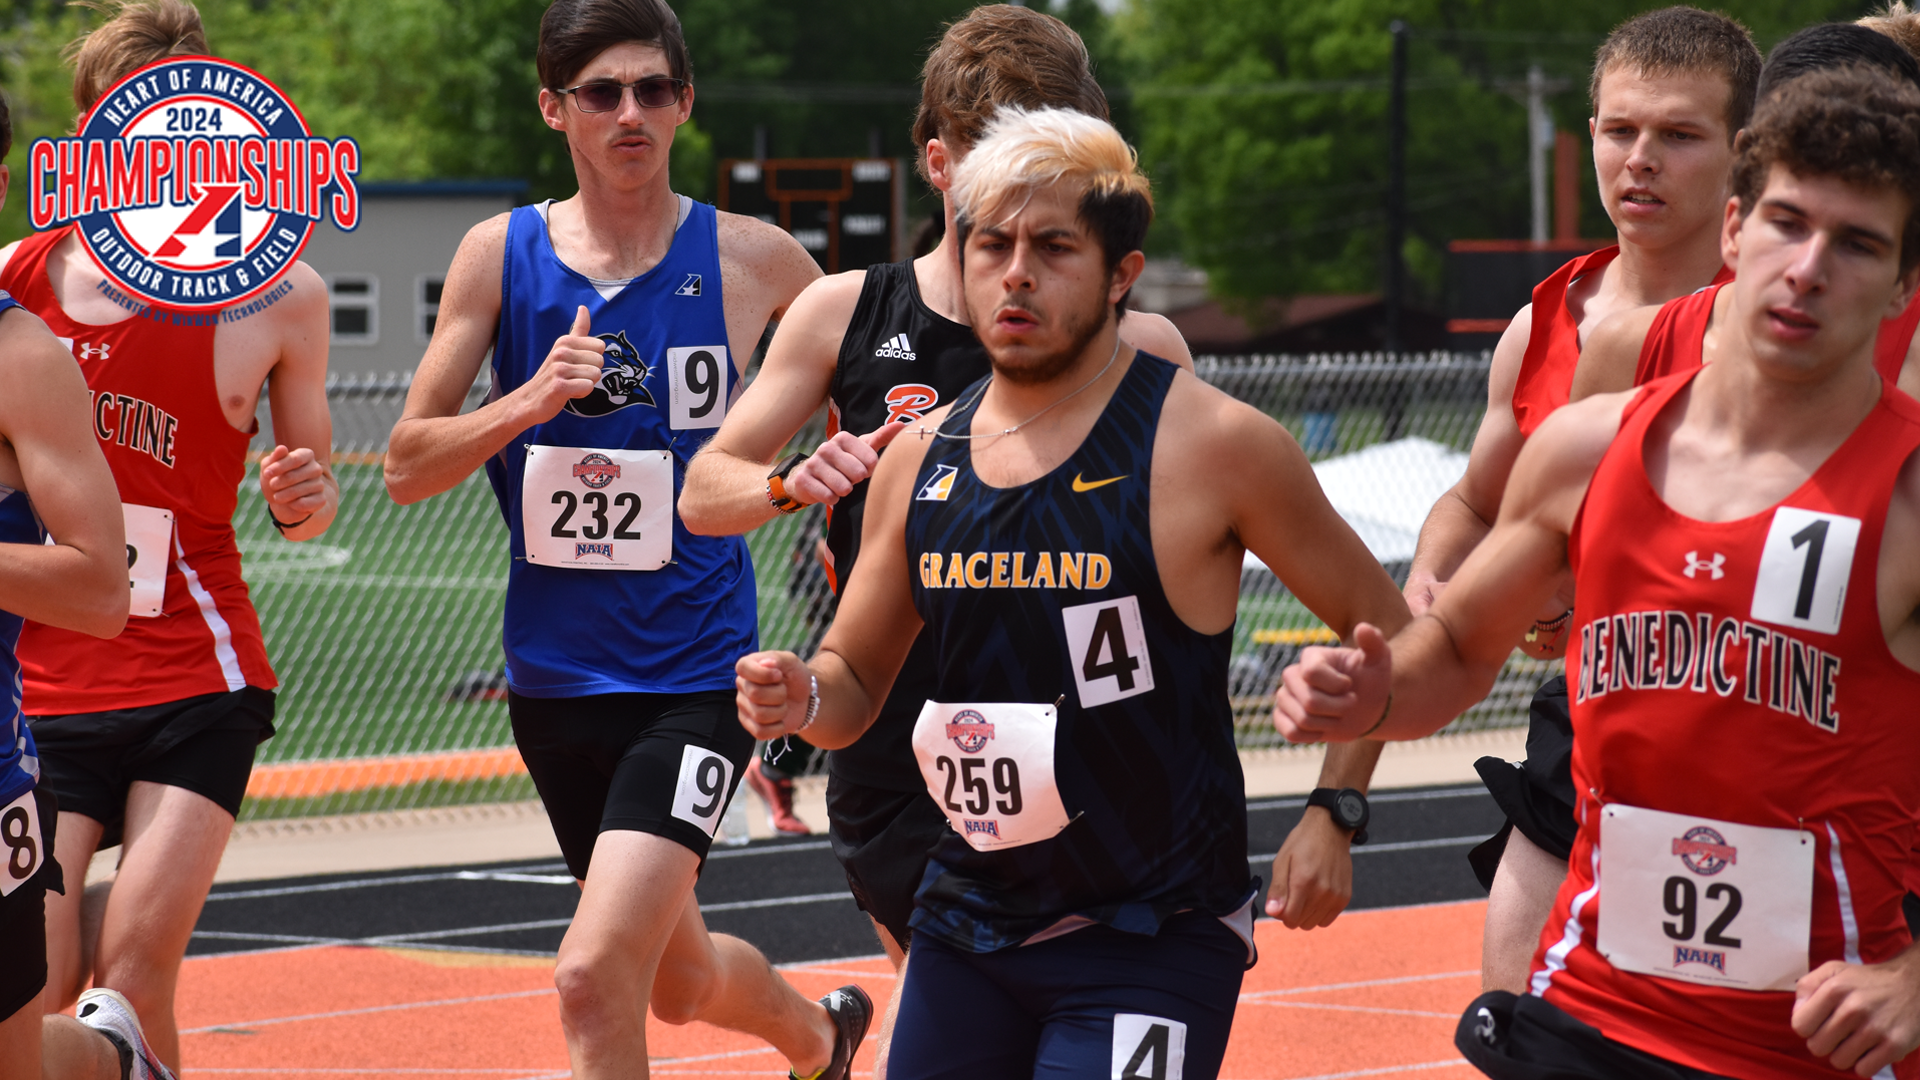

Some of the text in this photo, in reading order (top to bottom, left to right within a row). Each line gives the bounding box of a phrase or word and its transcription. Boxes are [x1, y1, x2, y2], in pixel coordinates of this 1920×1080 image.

[685, 350, 719, 418] 9
[875, 347, 917, 361] adidas
[551, 490, 642, 540] 232
[576, 543, 612, 558] NAIA
[919, 551, 1112, 590] GRACELAND
[1790, 519, 1831, 620] 1
[1082, 606, 1140, 692] 4
[1576, 610, 1841, 733] BENEDICTINE
[691, 755, 726, 818] 9
[936, 755, 1023, 816] 259
[1, 806, 37, 880] 8
[964, 820, 998, 837] NAIA
[1662, 875, 1743, 949] 92
[1675, 947, 1723, 970] NAIA
[1121, 1023, 1170, 1080] 4
